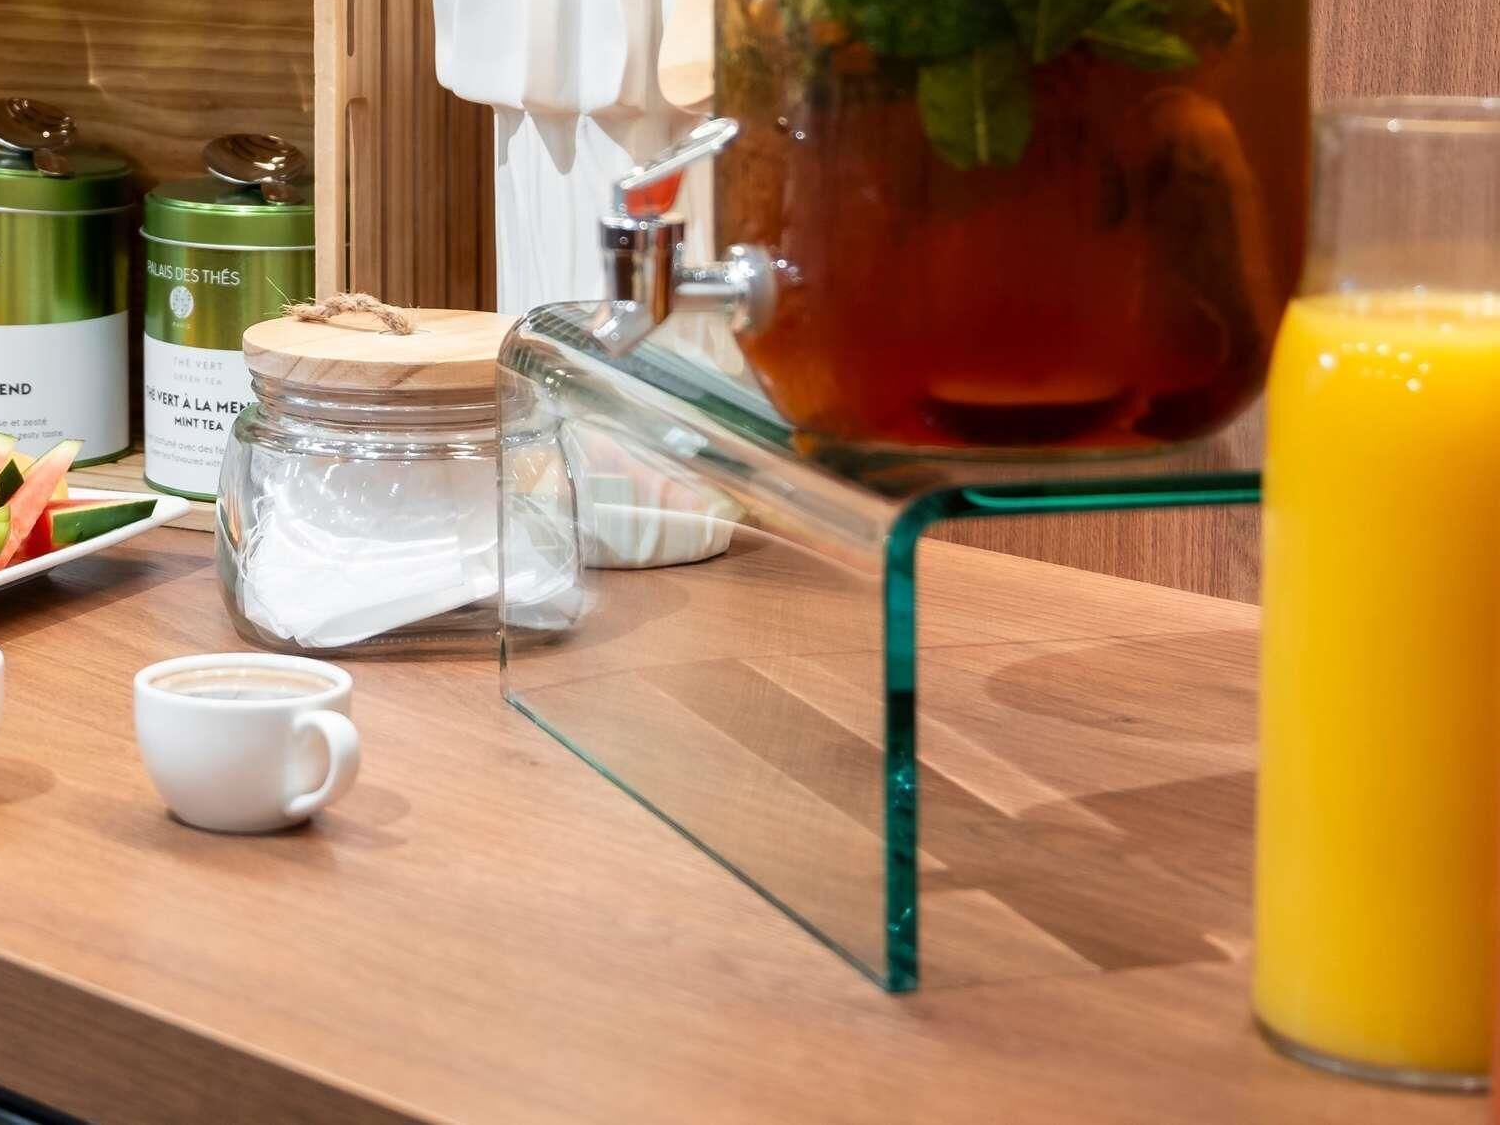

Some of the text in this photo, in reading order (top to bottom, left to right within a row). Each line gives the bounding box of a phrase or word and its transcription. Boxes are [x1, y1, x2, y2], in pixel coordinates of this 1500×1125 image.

[147, 259, 241, 286] PALAIS DES THÉS
[195, 360, 223, 371] VERT
[157, 390, 180, 406] VERT
[183, 393, 191, 409] À
[195, 398, 212, 412] LA
[10, 418, 20, 427] et
[174, 416, 224, 431] MINT TEA
[179, 442, 196, 452] avec
[198, 443, 213, 453] des
